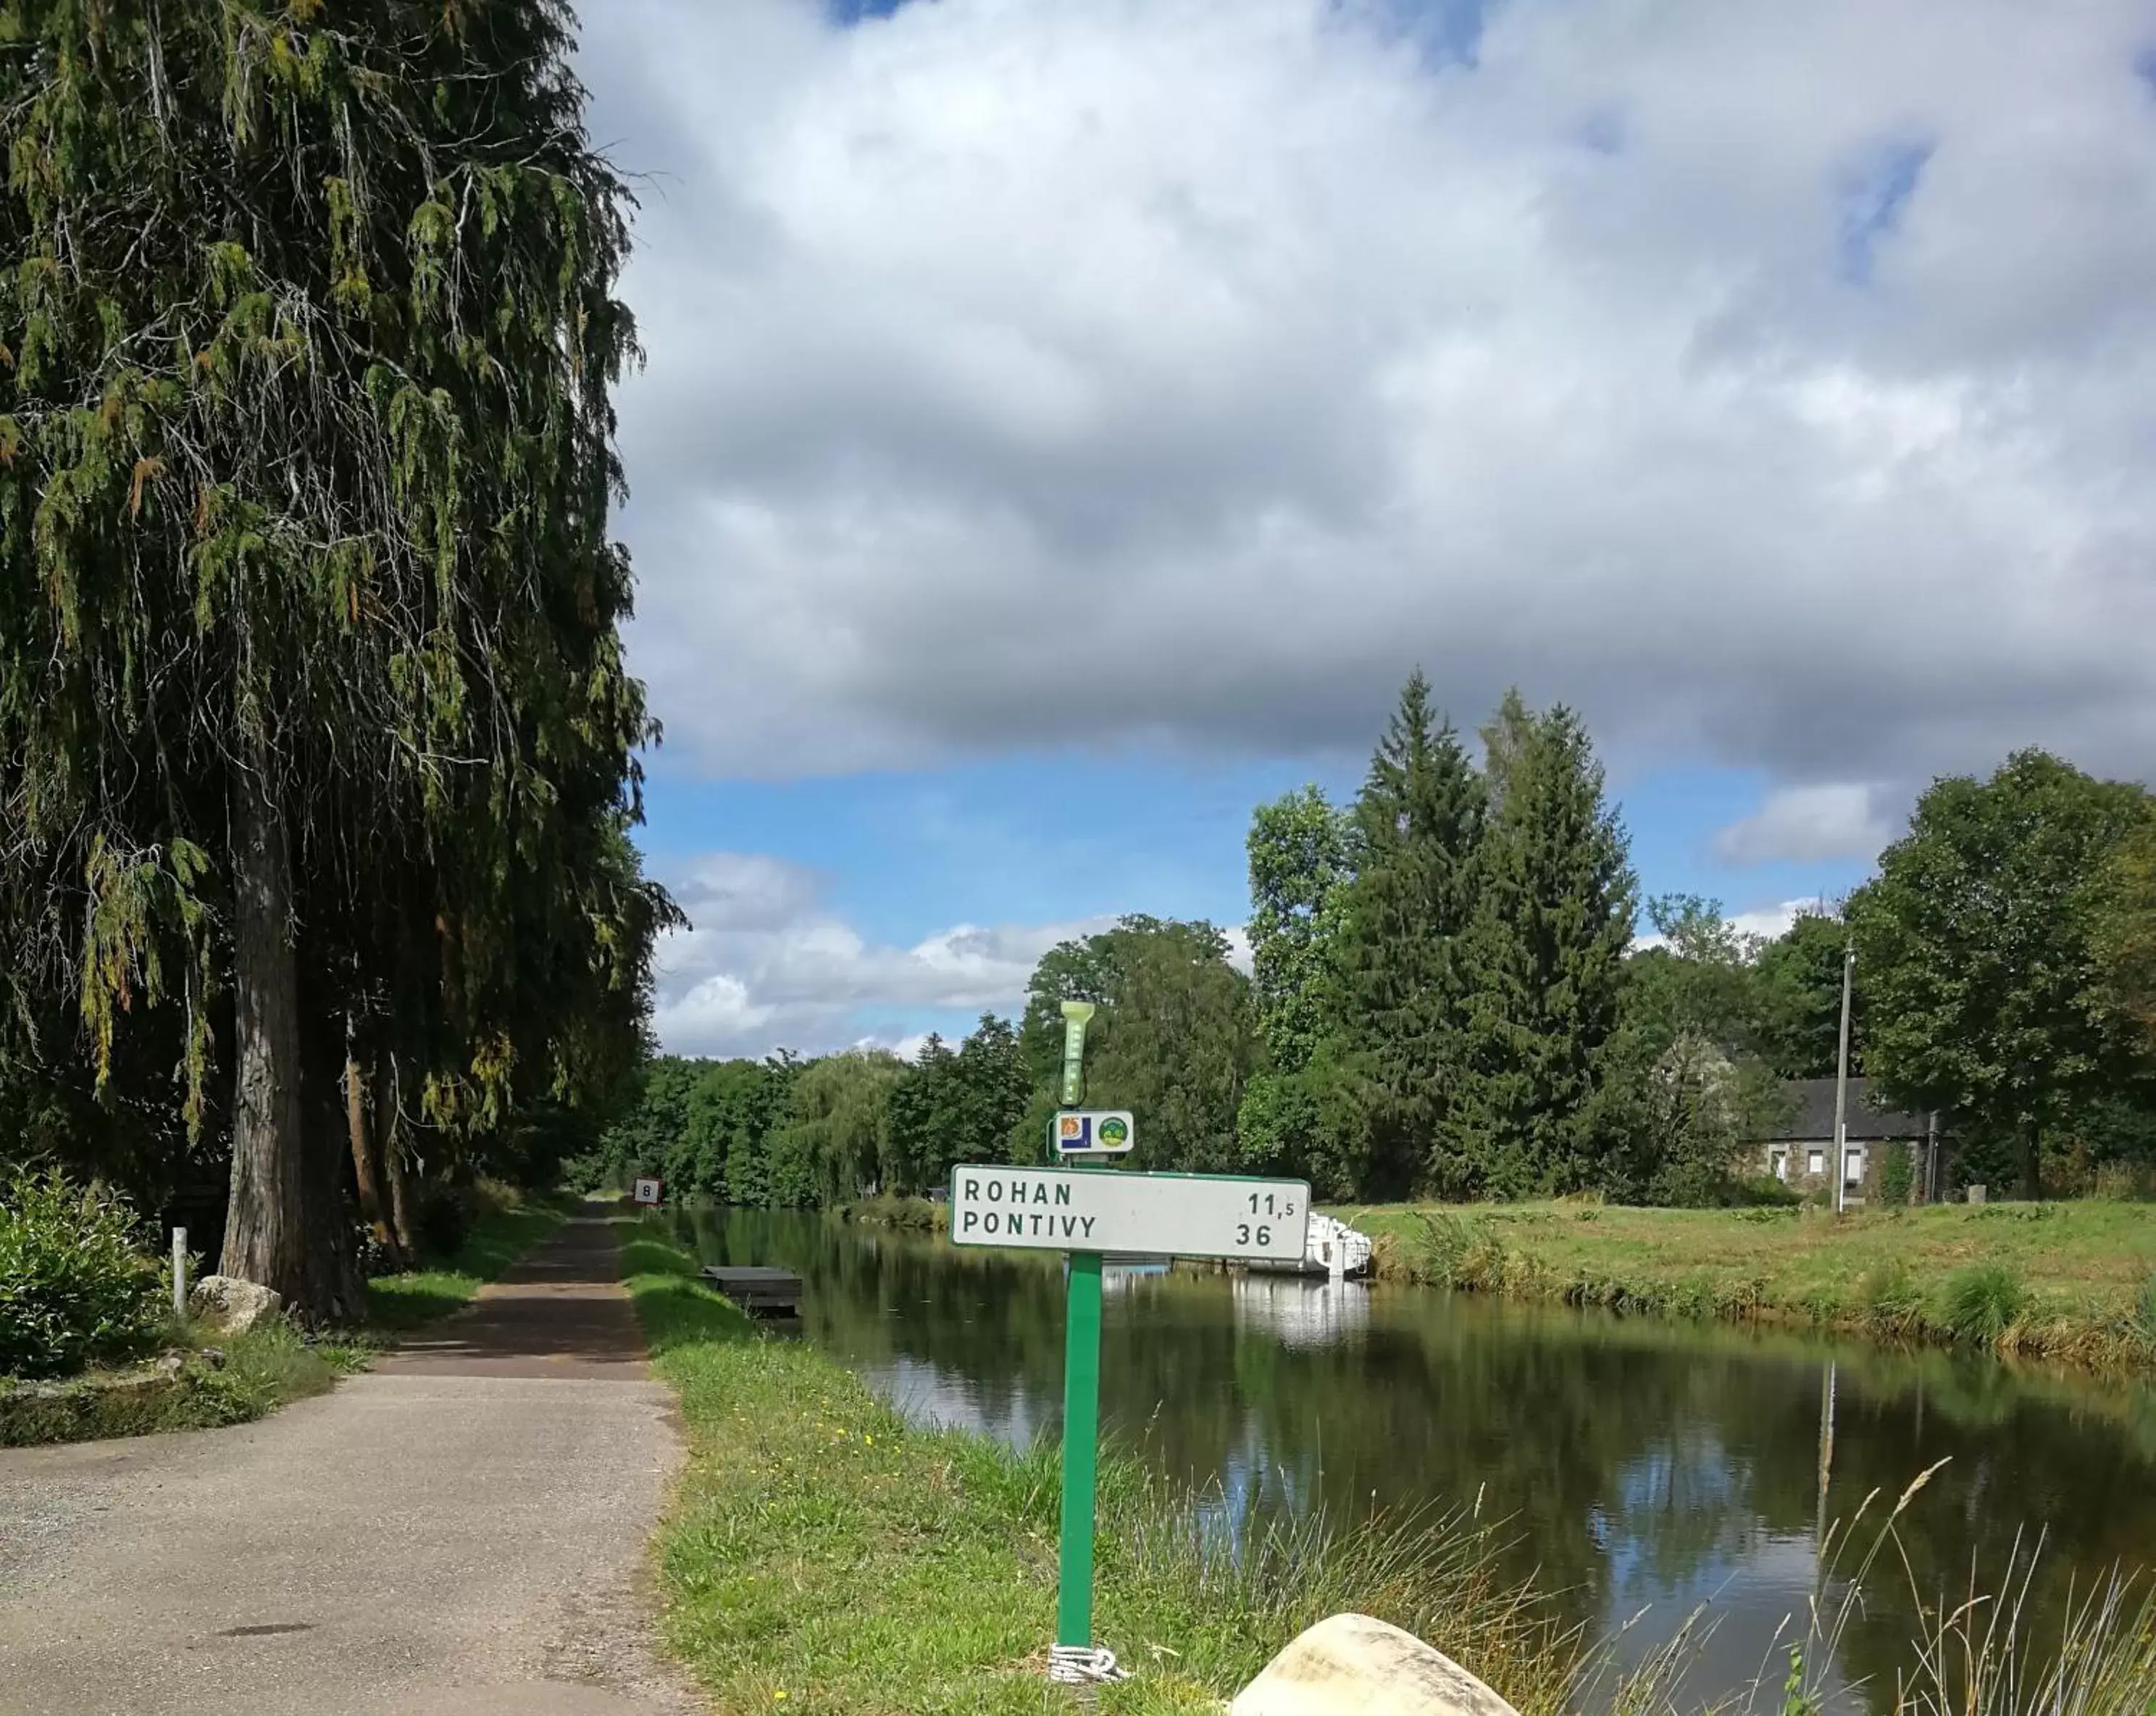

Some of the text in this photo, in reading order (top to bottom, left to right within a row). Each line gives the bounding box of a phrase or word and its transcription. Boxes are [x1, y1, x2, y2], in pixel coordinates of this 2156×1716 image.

[965, 1179, 1295, 1221] ROHAN 11,5
[964, 1211, 1271, 1247] PONTIVY 36
